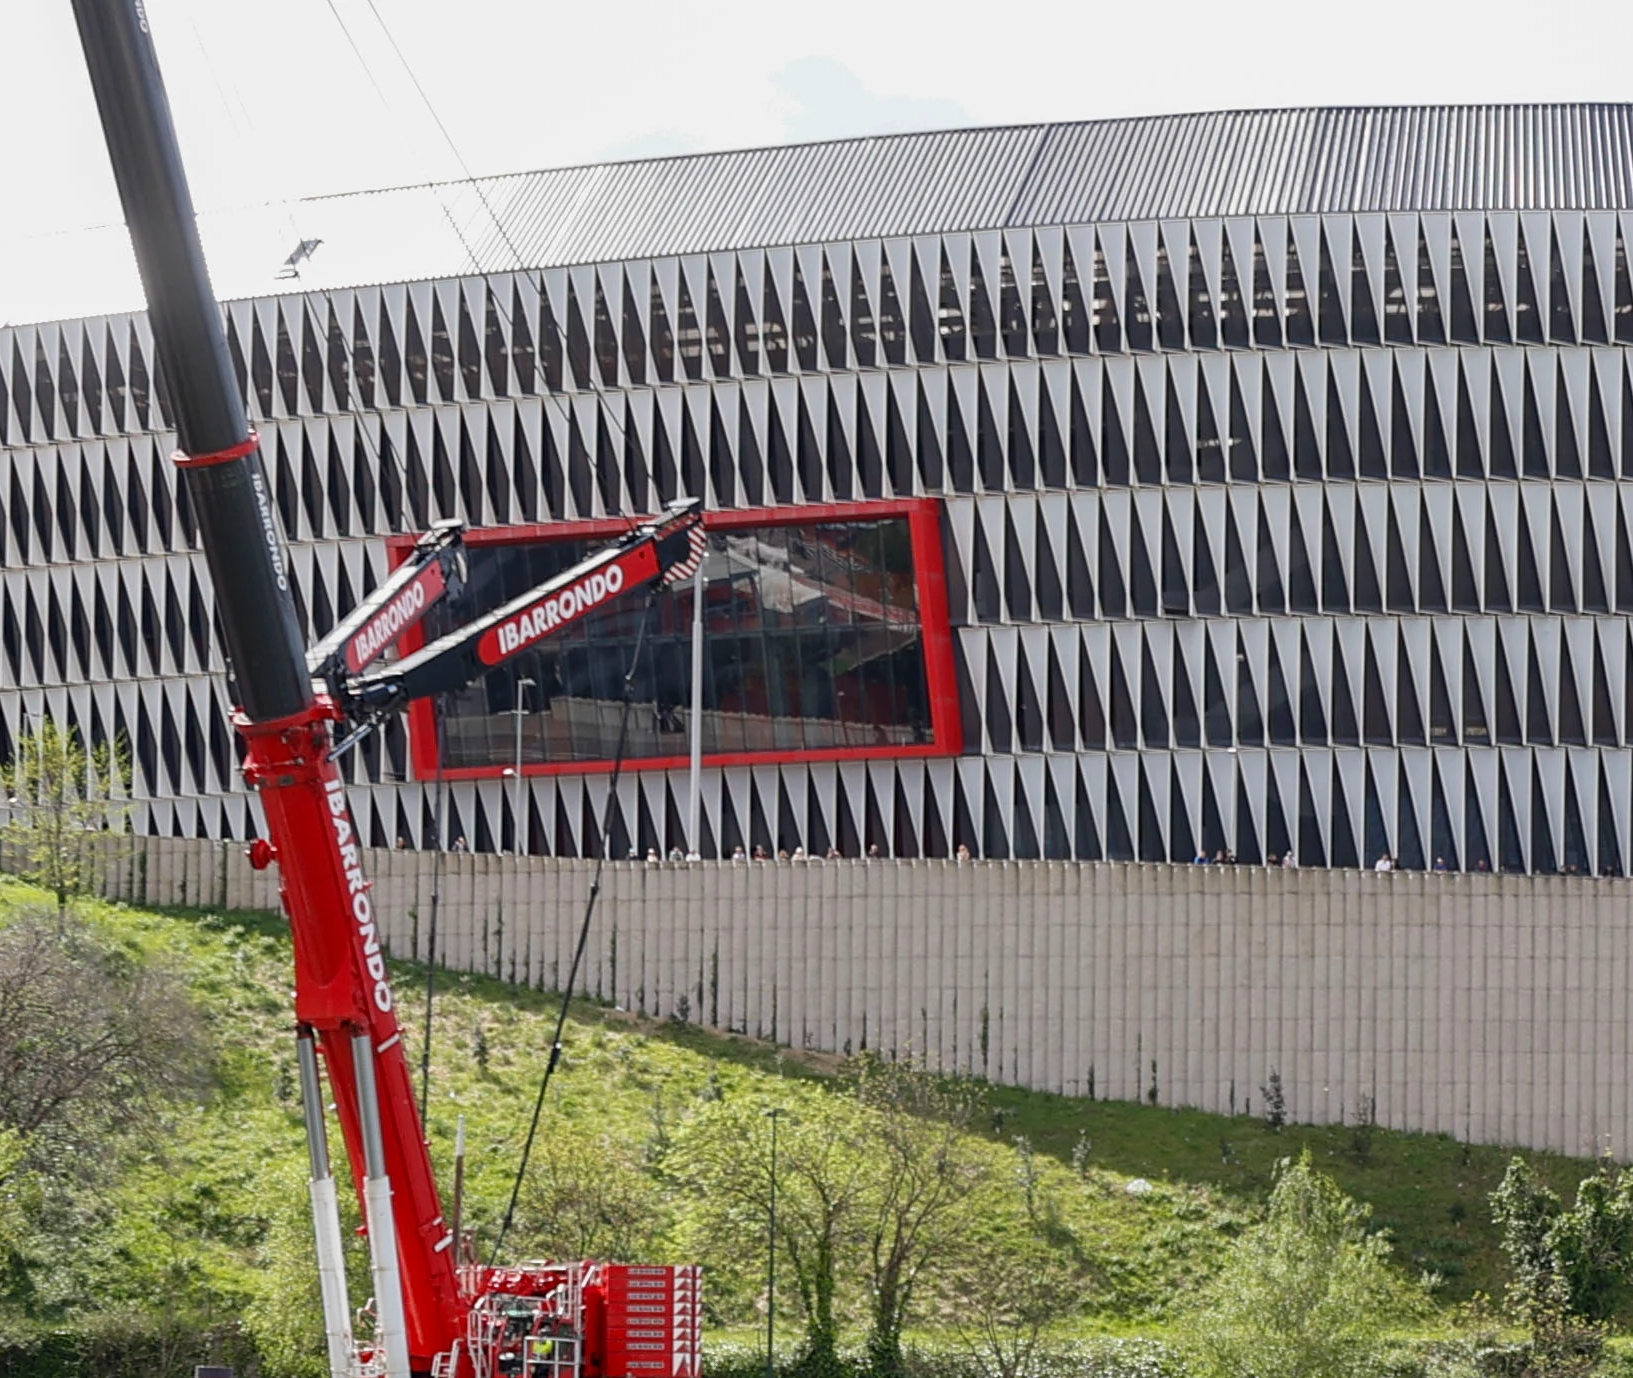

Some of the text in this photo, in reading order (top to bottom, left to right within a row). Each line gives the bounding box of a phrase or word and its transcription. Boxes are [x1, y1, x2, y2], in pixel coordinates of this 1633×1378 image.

[252, 473, 287, 591] IBARRONDO
[354, 580, 425, 664] IBARRONDO
[497, 564, 623, 655] IBARRONDO
[324, 779, 392, 1013] IBARRONDO
